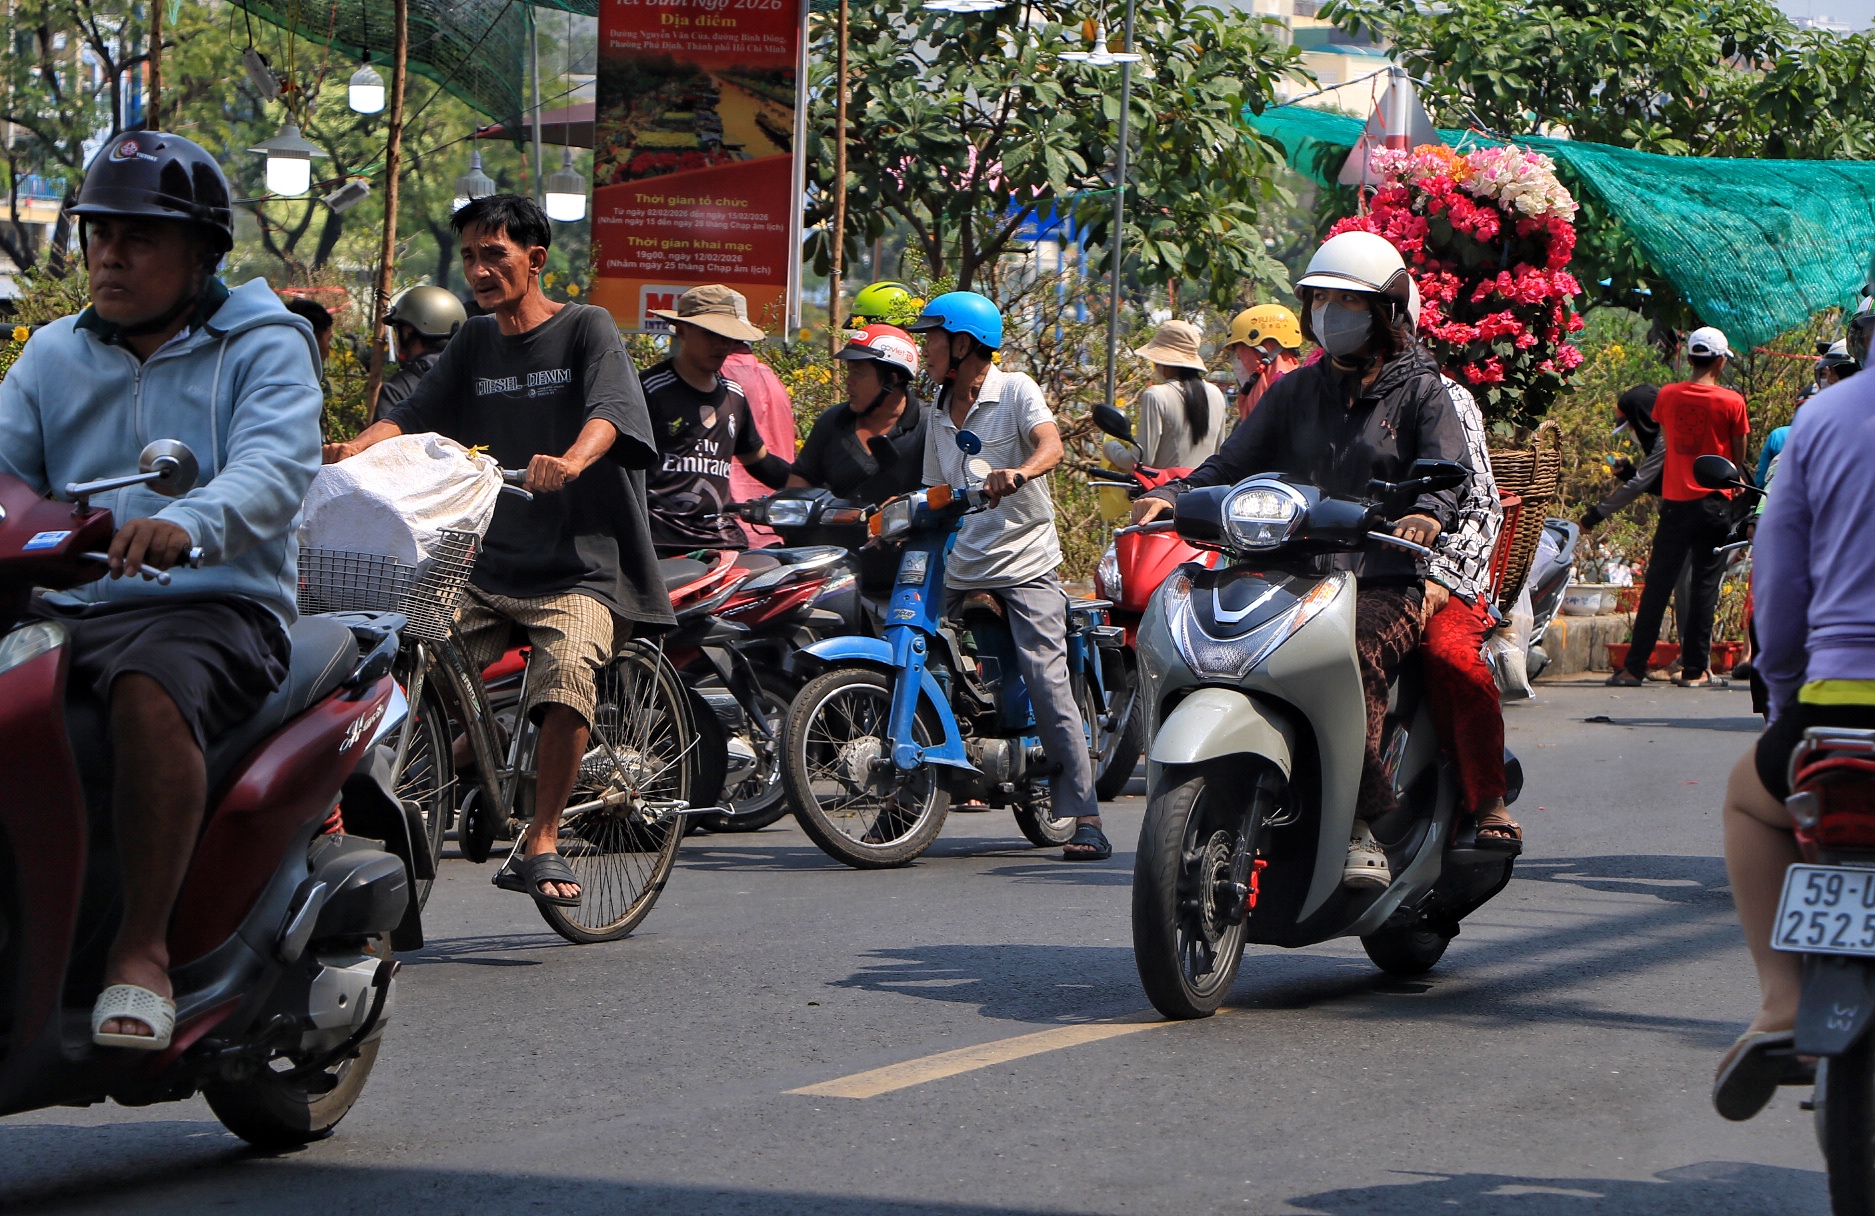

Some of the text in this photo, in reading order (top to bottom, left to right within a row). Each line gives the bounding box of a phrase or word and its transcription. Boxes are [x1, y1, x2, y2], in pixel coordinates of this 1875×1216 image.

[661, 11, 737, 28] Địa điểm
[635, 193, 748, 207] Thời gian tổ chức
[706, 211, 726, 220] ngày
[728, 212, 769, 221] 15/02/2026
[624, 217, 644, 226] ngày
[673, 219, 693, 228] ngày
[730, 221, 751, 230] Chạp
[766, 223, 784, 233] lịch)
[627, 236, 752, 252] Thời gian khai mạc
[668, 252, 691, 261] ngày
[694, 253, 743, 262] 12/02/2026
[639, 261, 662, 270] ngày
[664, 261, 676, 269] 25
[677, 262, 705, 272] tháng
[706, 263, 732, 272] Chạp
[750, 265, 771, 275] lịch)
[476, 376, 522, 395] DIESEL
[527, 369, 571, 387] DENIM
[694, 438, 719, 456] Fly
[662, 452, 732, 479] Emirates
[1782, 910, 1875, 948] 252.5
